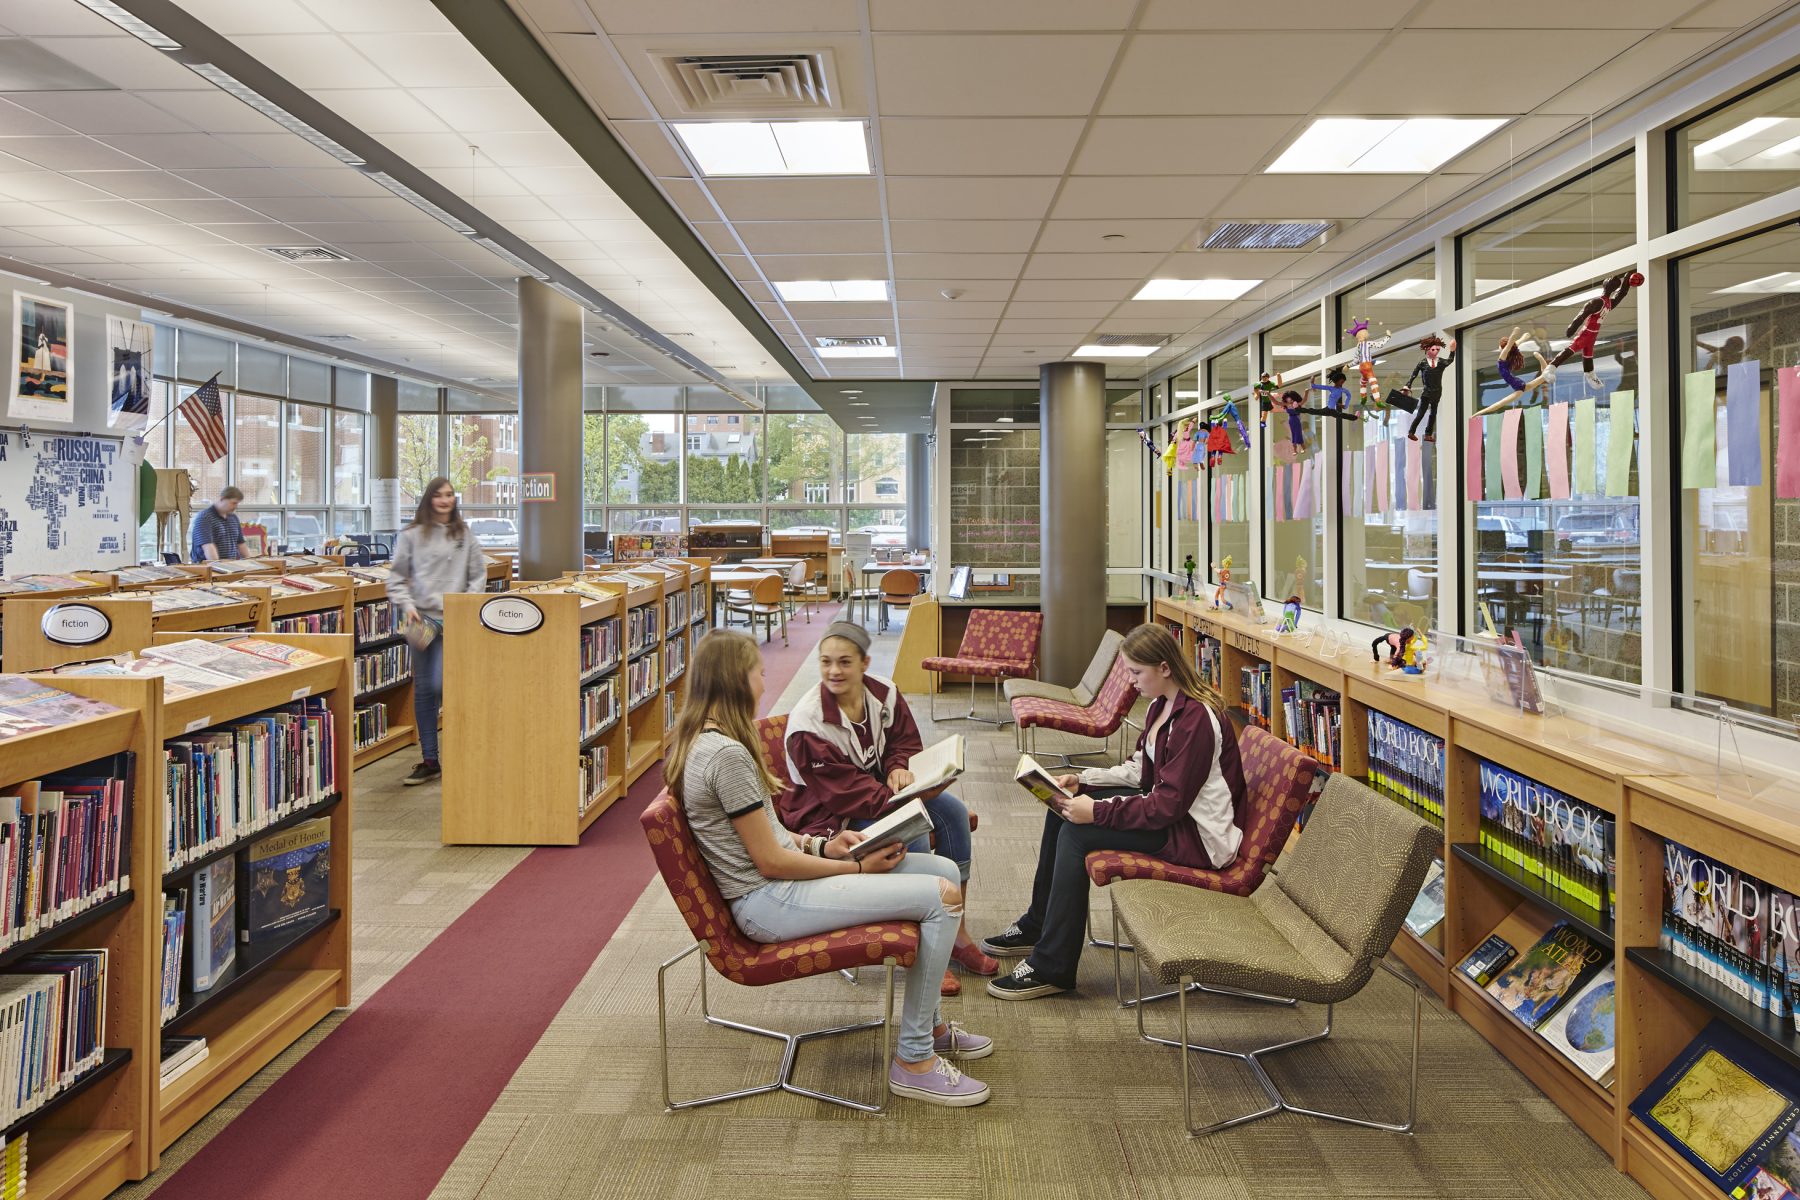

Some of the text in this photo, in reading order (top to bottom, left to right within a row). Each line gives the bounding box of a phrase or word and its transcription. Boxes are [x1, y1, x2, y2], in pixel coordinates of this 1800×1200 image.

[57, 438, 102, 462] RUSSIA
[80, 468, 104, 484] CHINA
[62, 620, 88, 628] fiction
[498, 610, 524, 618] fiction
[1234, 632, 1260, 656] NOVELS
[1368, 715, 1407, 752] WORLD
[1480, 764, 1601, 848] WORLD BOOK
[260, 830, 325, 854] Medal of Honor
[1666, 844, 1760, 921] WORLD
[1541, 943, 1586, 974] ATLAS
[1553, 927, 1602, 964] WORLD
[1728, 1107, 1800, 1182] CENTENNIAL EDITION
